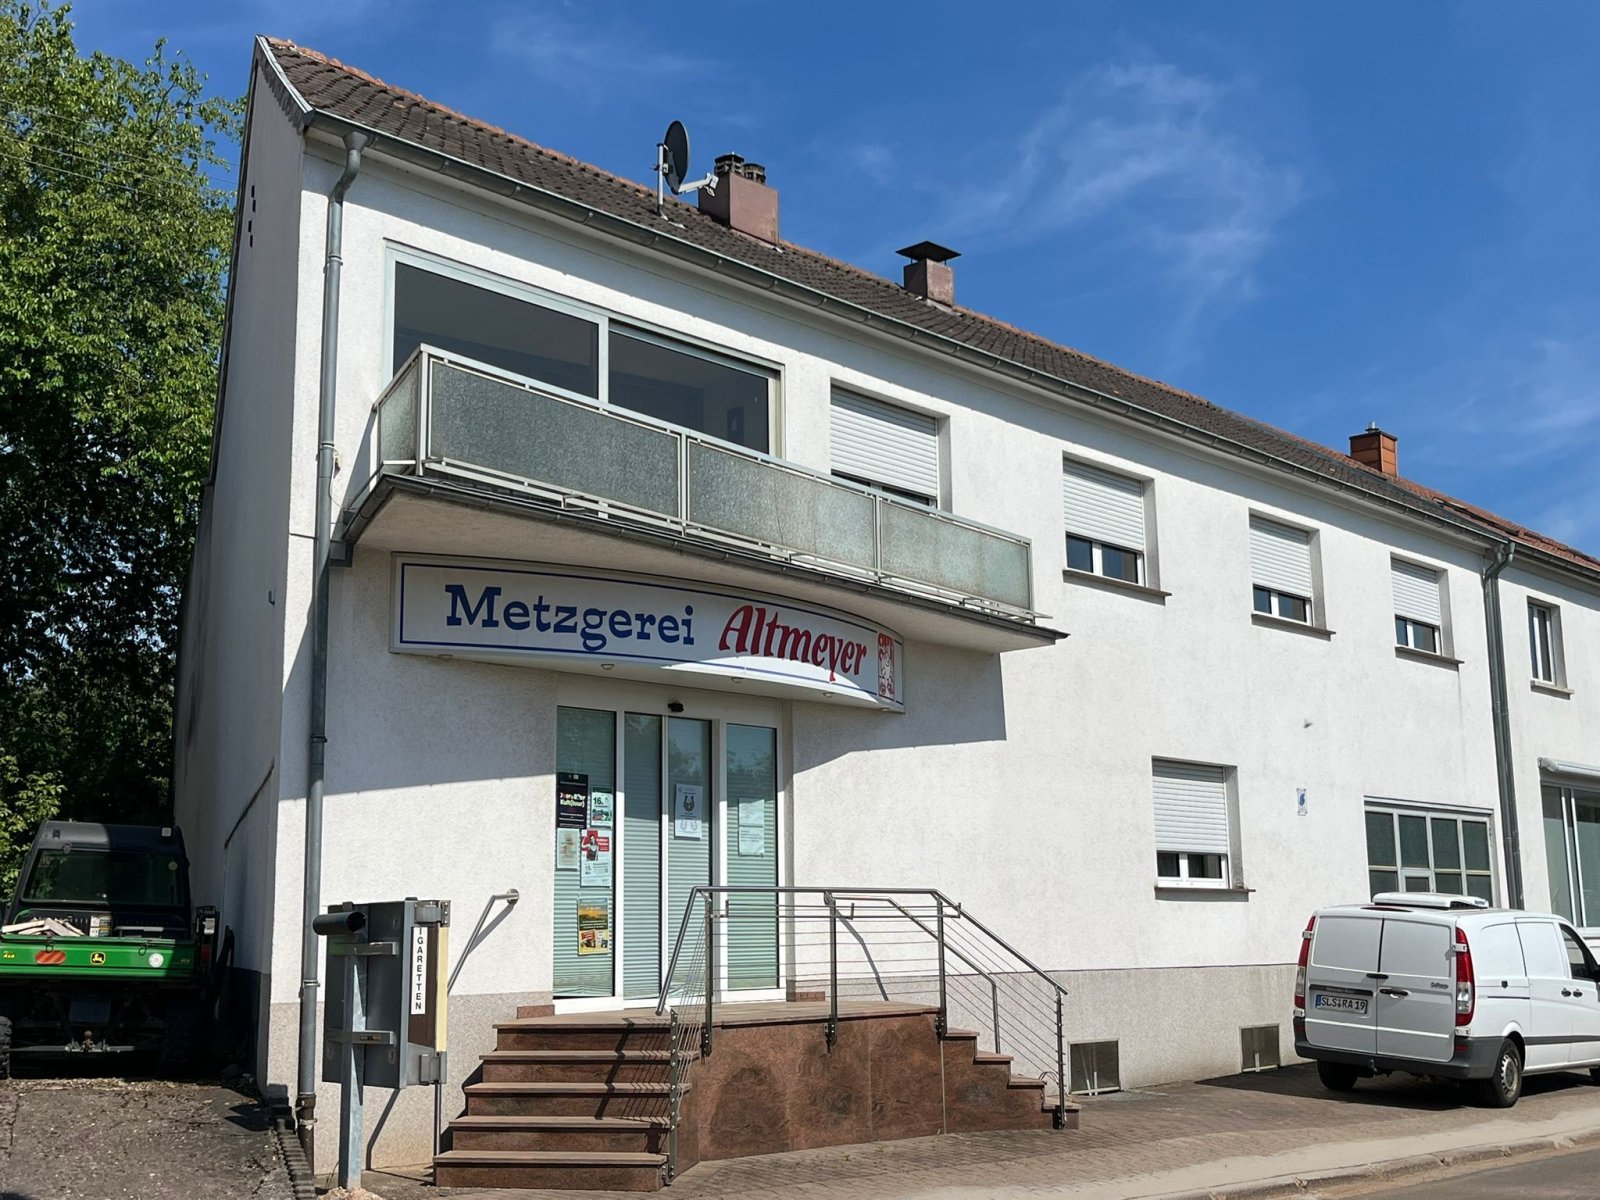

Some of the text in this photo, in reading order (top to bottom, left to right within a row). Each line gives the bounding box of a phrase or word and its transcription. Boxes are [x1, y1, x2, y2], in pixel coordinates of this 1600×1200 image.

[445, 584, 868, 683] Metzgerei Altmeyer
[1321, 996, 1366, 1011] SLS RA 19
